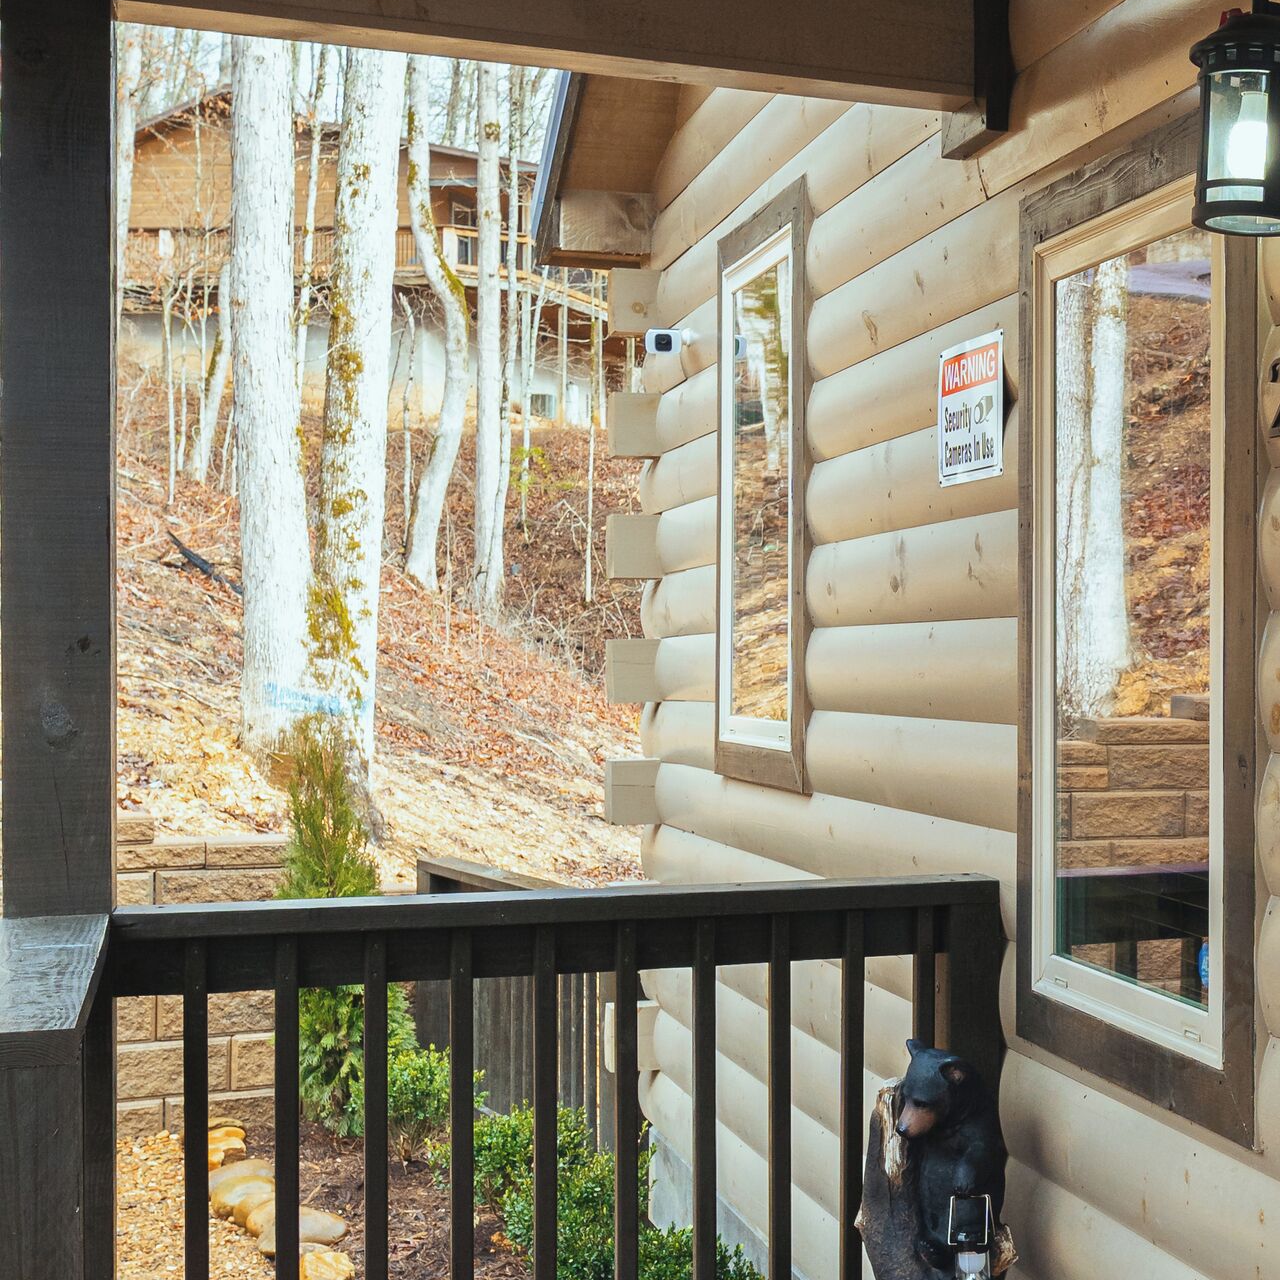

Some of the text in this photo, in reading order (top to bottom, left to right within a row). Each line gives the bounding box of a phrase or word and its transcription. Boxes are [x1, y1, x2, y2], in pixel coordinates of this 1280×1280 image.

[944, 348, 996, 392] WARNING
[944, 403, 972, 434] Security
[944, 433, 994, 468] Cameras In Use
